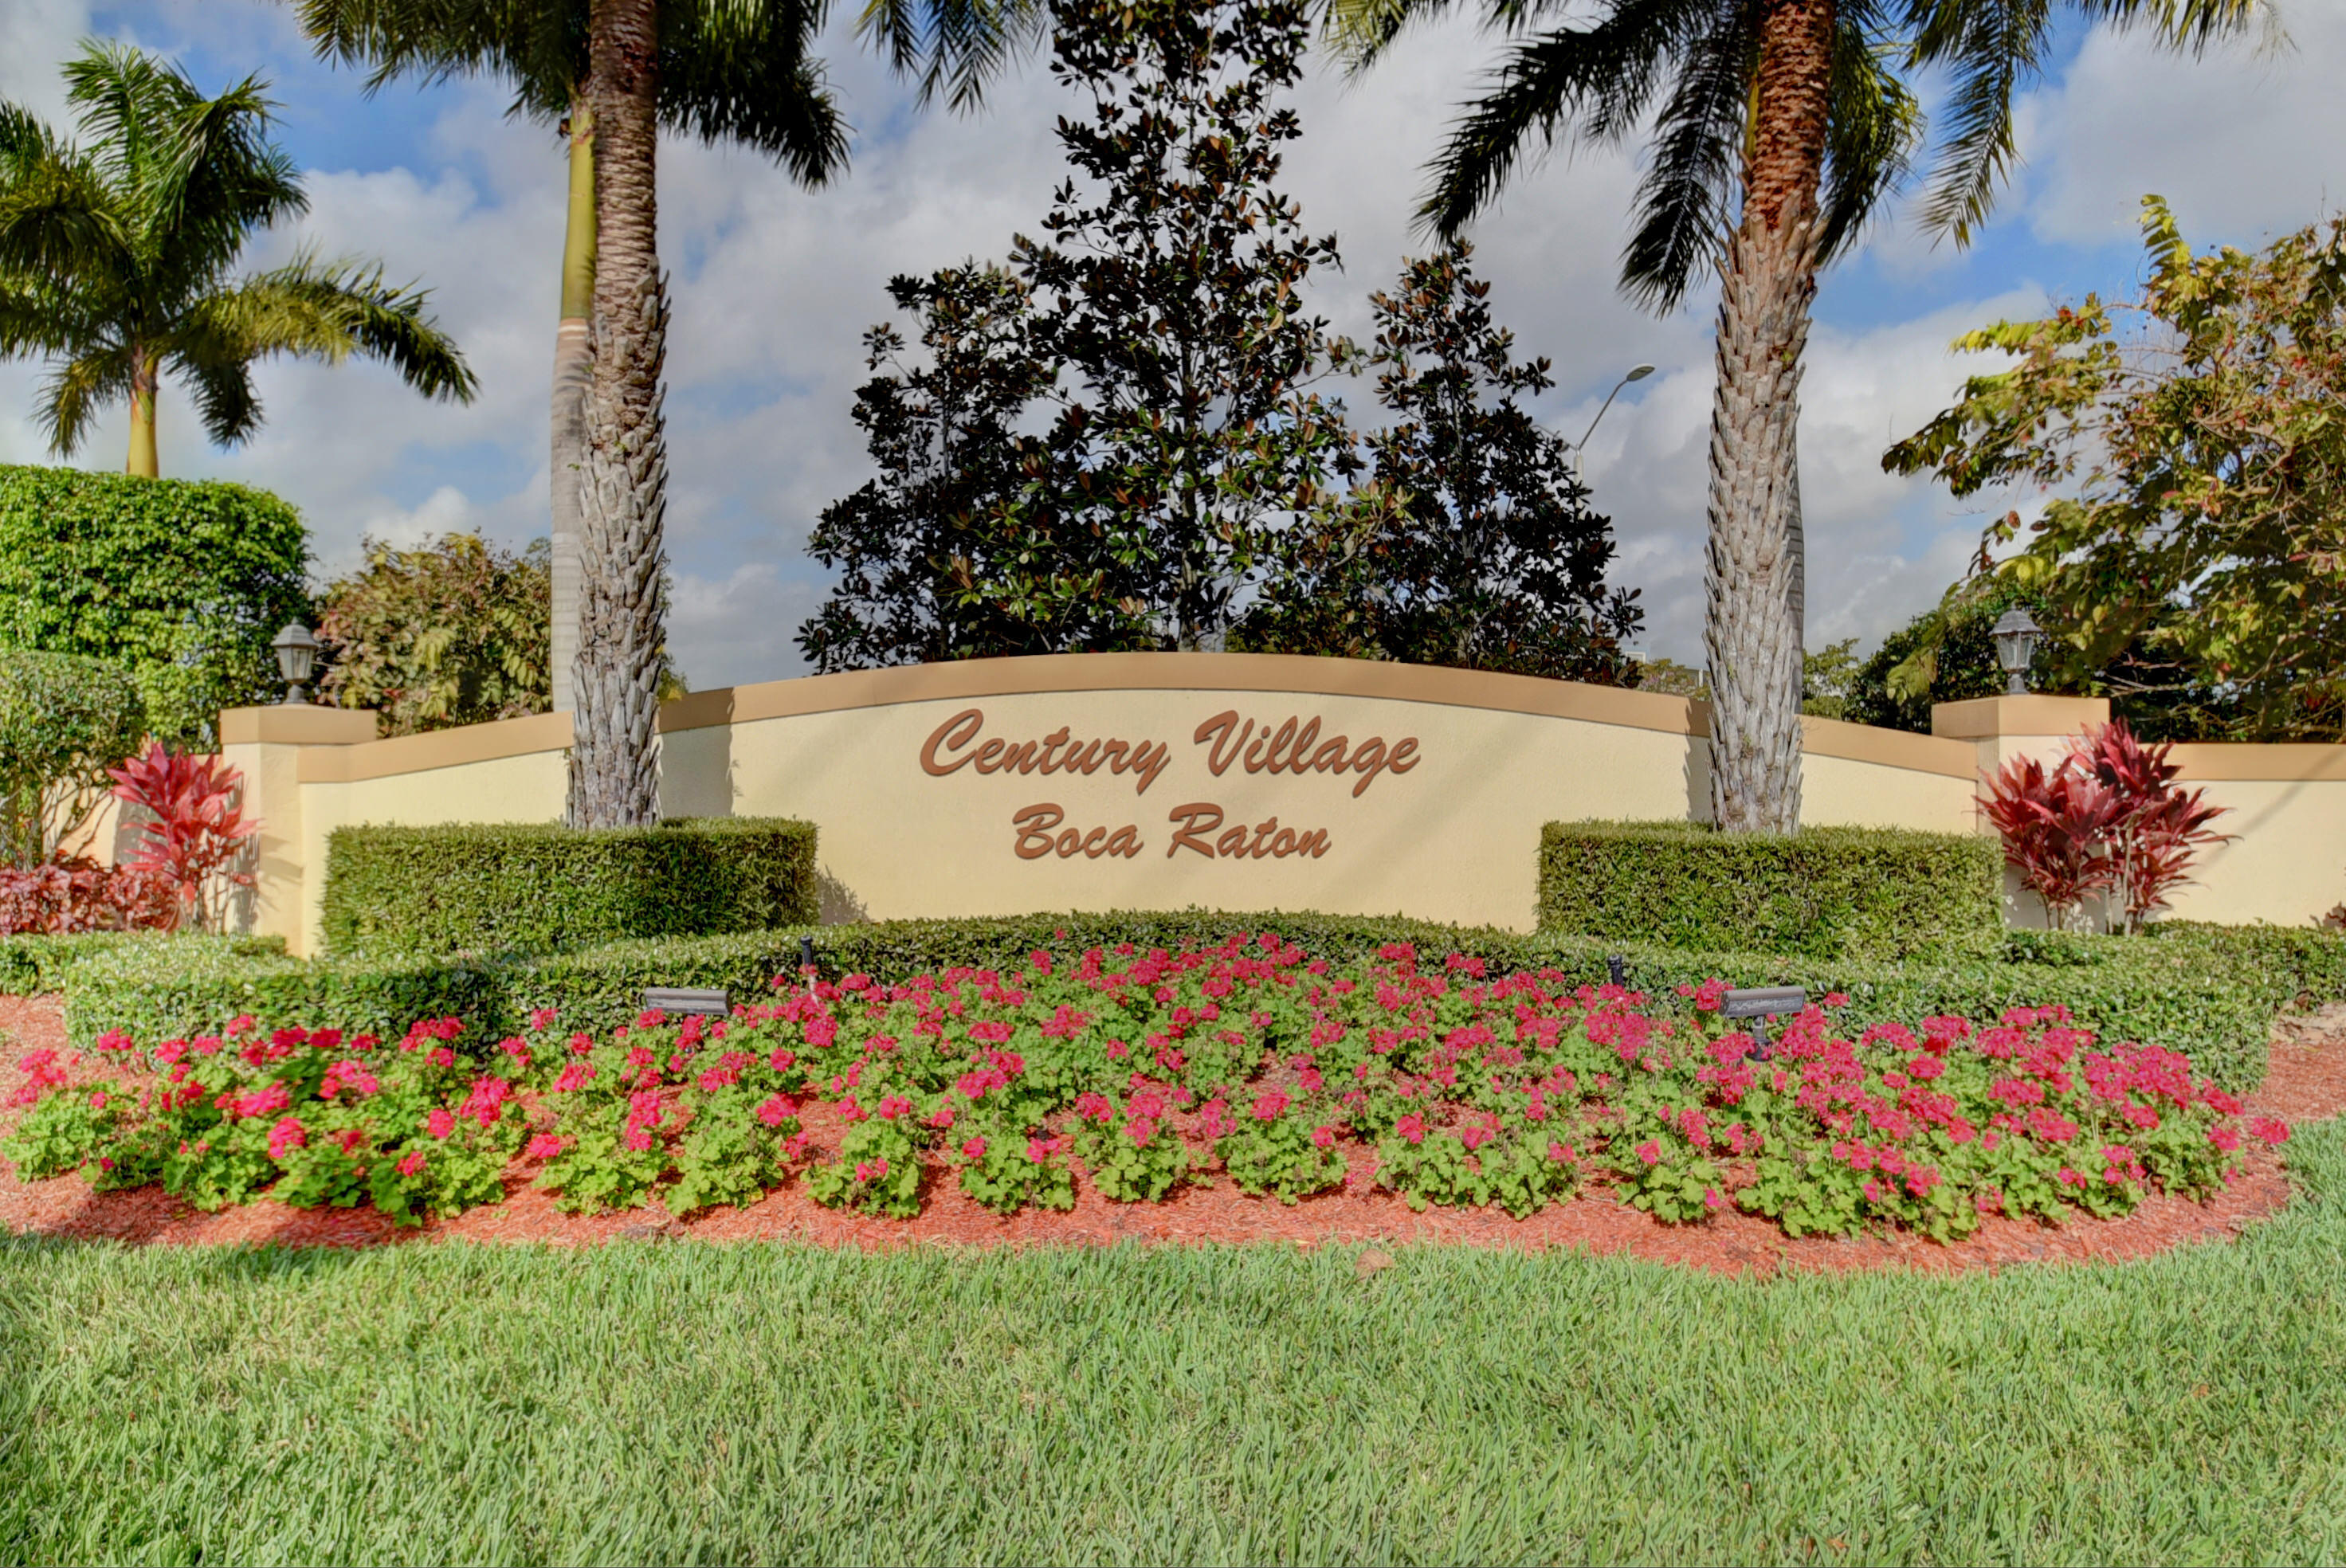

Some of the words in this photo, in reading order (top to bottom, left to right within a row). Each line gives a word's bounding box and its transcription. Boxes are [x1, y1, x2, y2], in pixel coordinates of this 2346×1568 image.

[920, 708, 1171, 796] Century
[1194, 710, 1422, 798] Village
[1012, 803, 1144, 860] Boca
[1167, 802, 1332, 860] Raton
